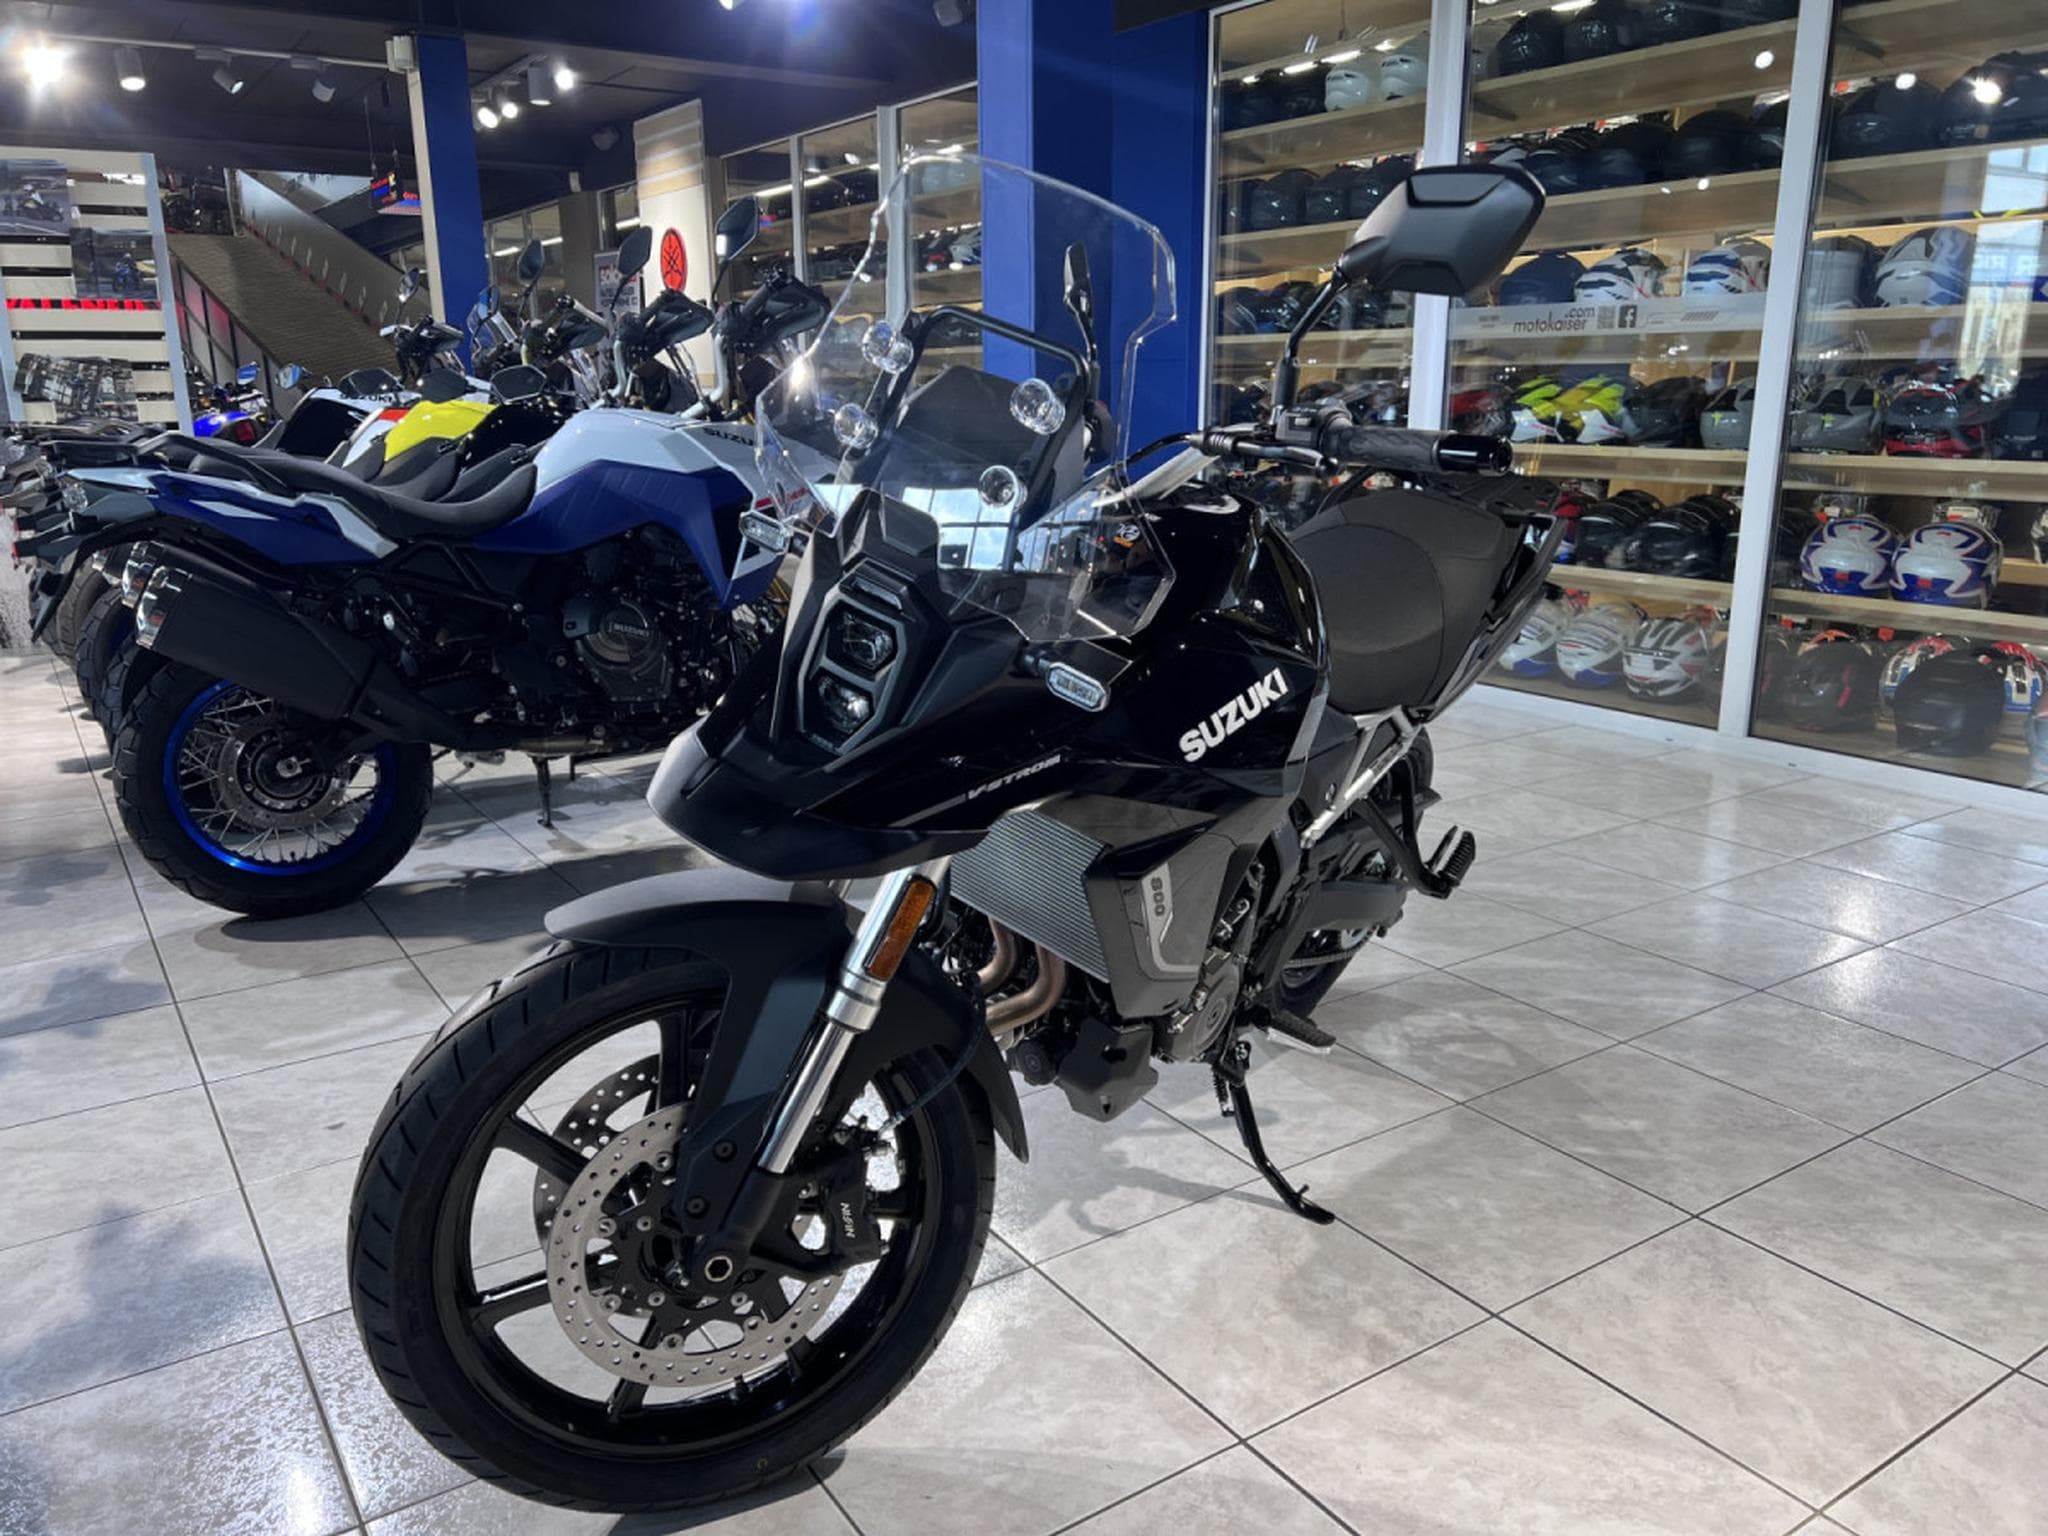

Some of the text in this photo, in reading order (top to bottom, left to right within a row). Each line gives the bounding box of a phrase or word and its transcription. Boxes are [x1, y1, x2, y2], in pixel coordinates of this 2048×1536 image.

[1564, 305, 1596, 319] .com
[1178, 667, 1289, 763] SUZUKI
[1150, 877, 1166, 918] 800
